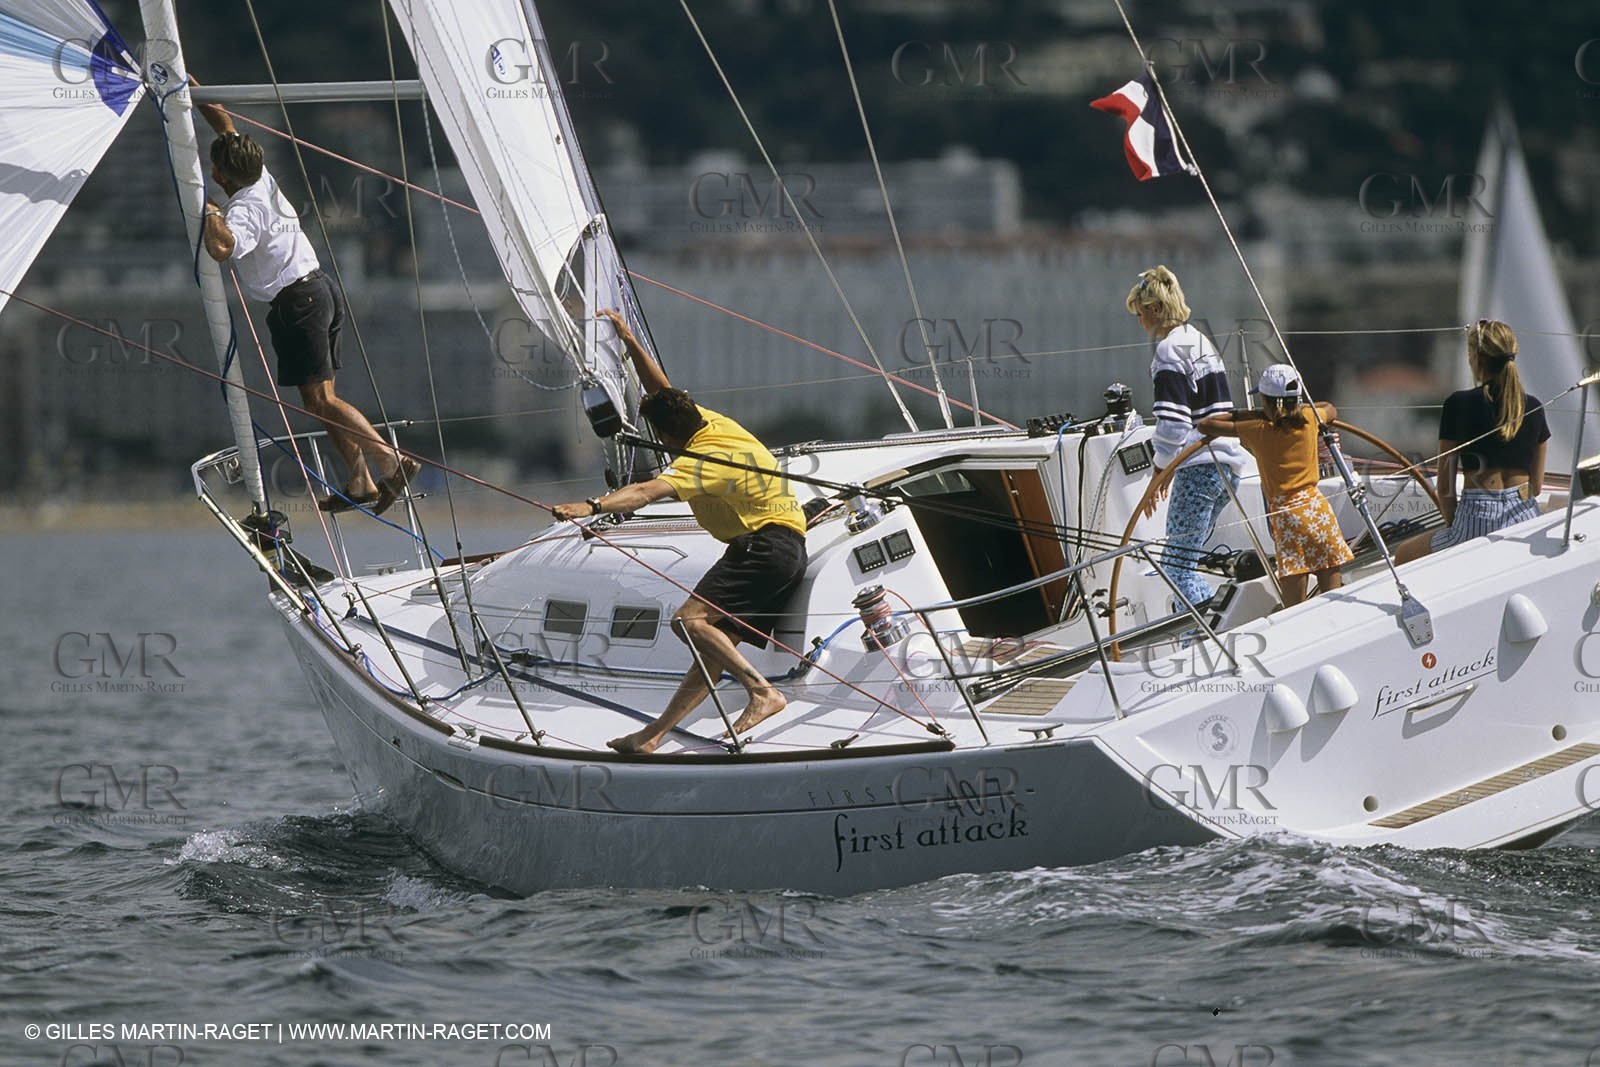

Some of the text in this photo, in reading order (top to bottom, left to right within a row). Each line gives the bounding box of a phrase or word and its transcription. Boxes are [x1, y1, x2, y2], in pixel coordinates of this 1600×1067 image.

[1372, 647, 1495, 720] first attack
[833, 808, 1029, 872] first attack
